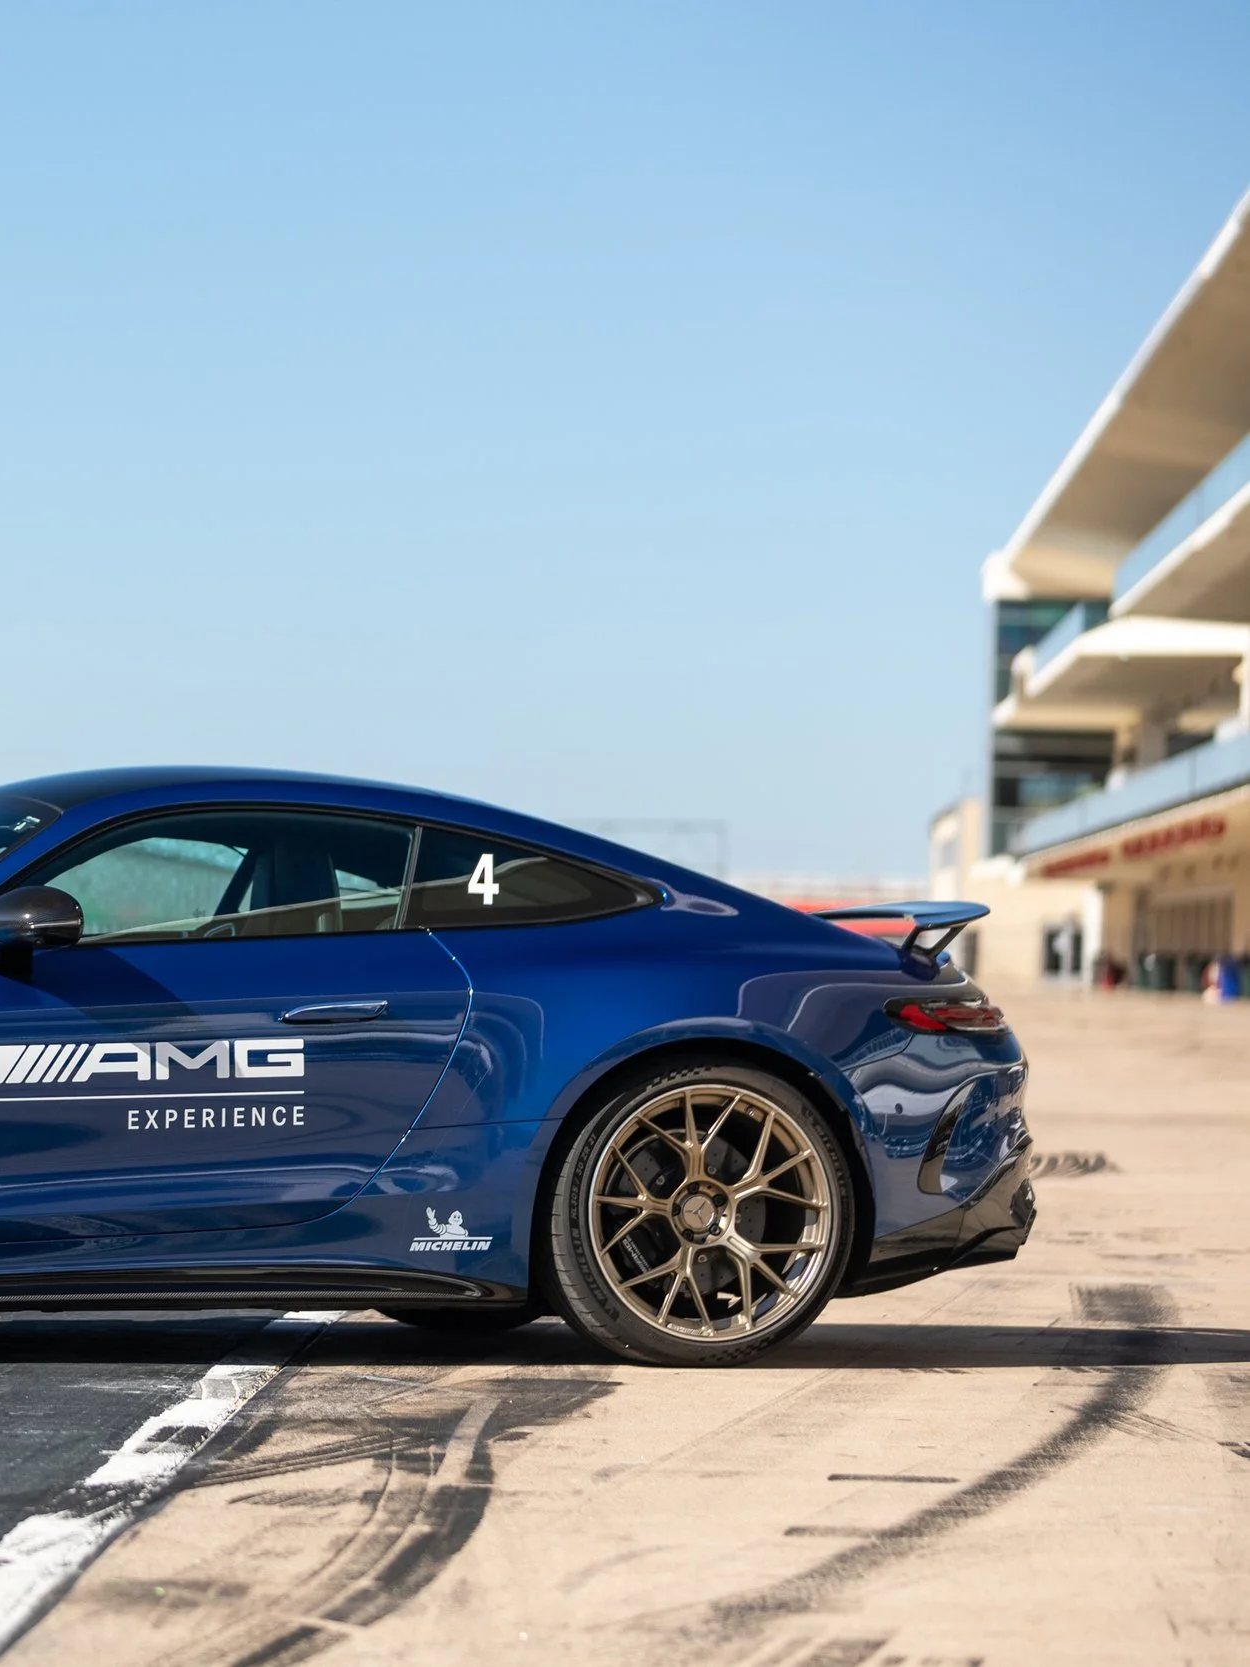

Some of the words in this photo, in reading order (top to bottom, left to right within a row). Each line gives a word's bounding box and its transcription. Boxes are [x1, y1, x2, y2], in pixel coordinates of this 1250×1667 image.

[468, 853, 499, 905] 4
[72, 1039, 304, 1082] AMG
[127, 1105, 305, 1130] EXPERIENCE
[409, 1241, 491, 1251] MICHELIN
[572, 1227, 605, 1303] MICHELIN
